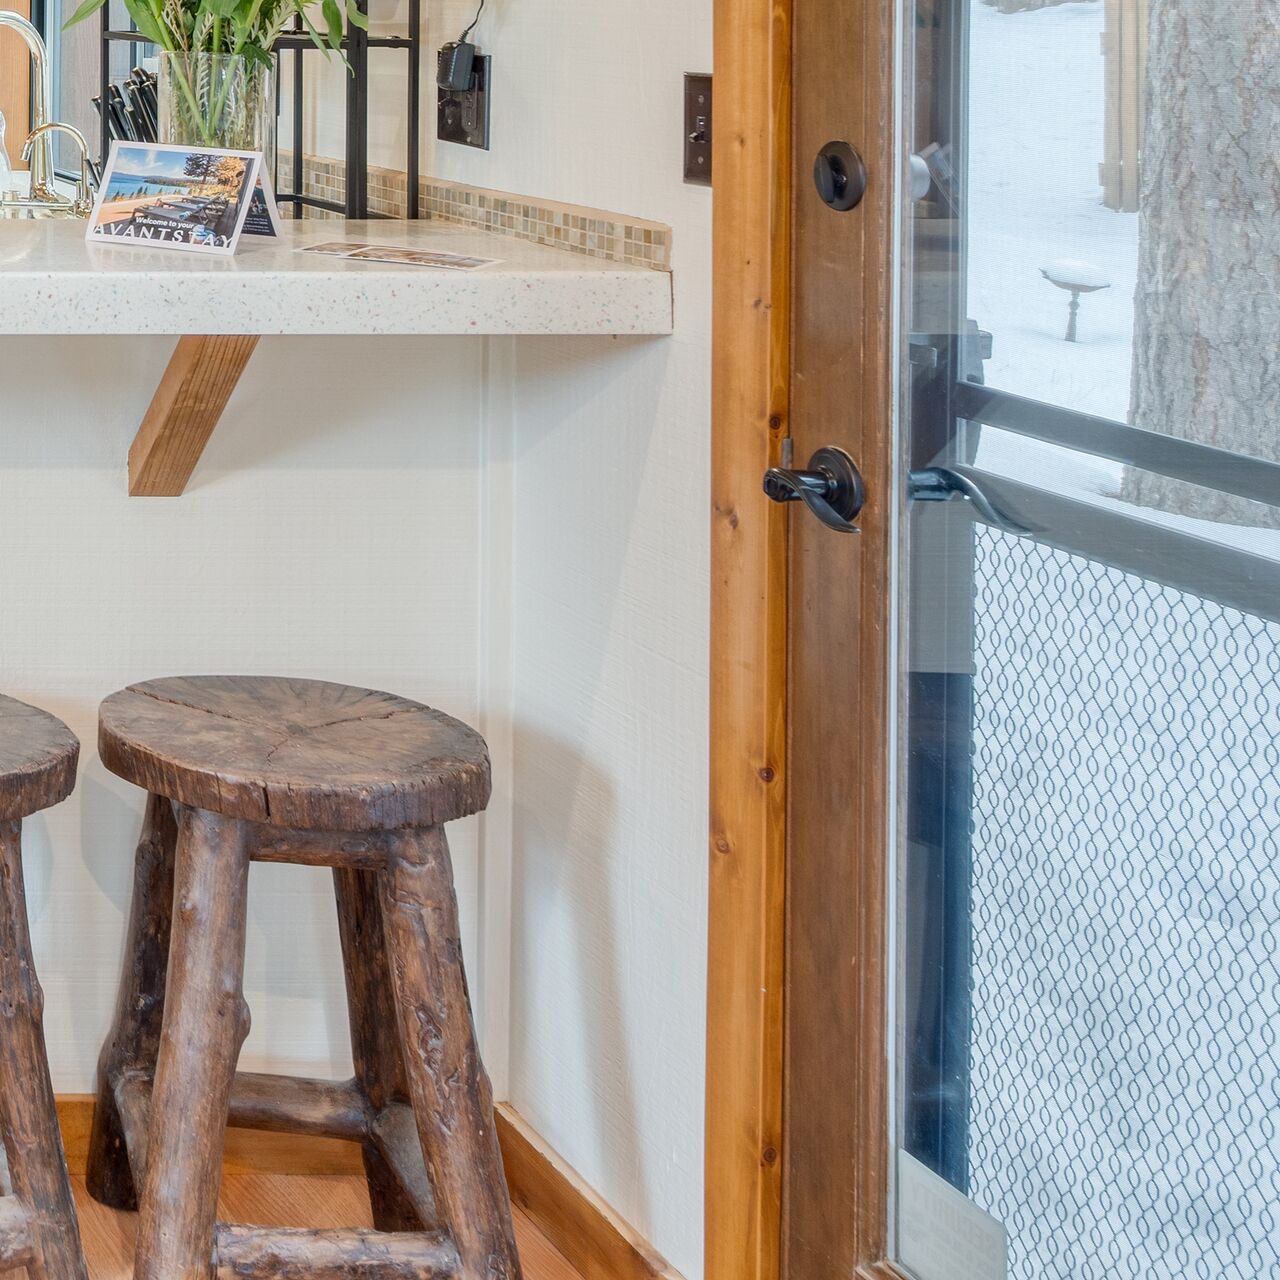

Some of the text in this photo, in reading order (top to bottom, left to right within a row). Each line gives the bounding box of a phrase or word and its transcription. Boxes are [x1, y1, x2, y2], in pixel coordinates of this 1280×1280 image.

[135, 216, 194, 230] Welcome to your
[93, 222, 234, 249] AVANTSTAY
